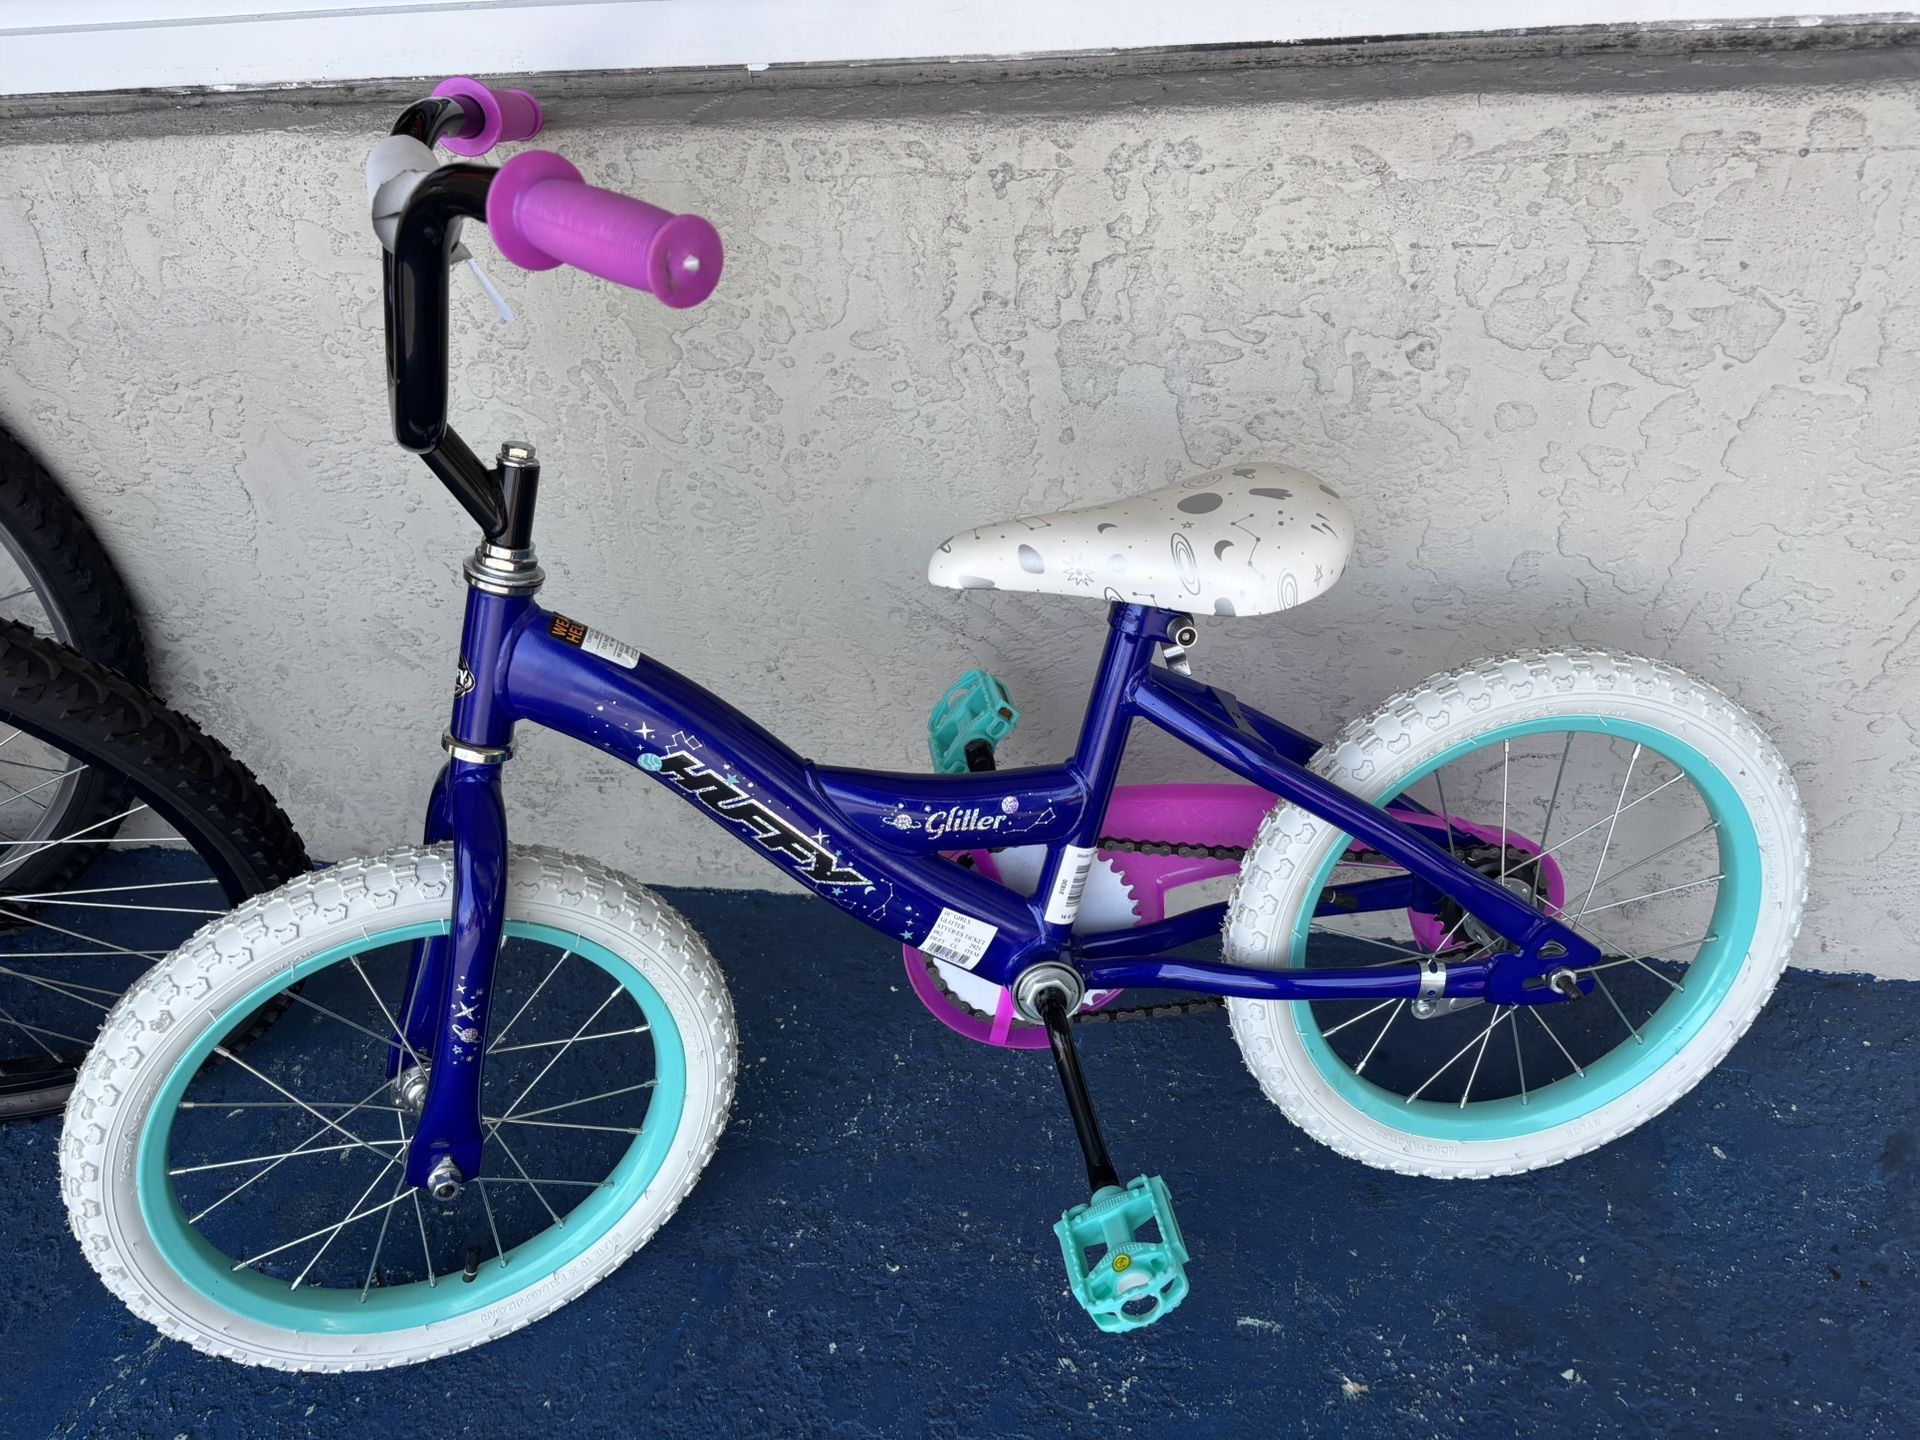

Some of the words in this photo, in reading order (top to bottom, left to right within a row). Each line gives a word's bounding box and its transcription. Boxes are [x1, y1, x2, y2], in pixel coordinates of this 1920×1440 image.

[661, 750, 873, 886] HUFFY
[925, 805, 1008, 840] Glitter
[940, 917, 965, 930] GLITTER
[953, 914, 971, 925] GIRLS
